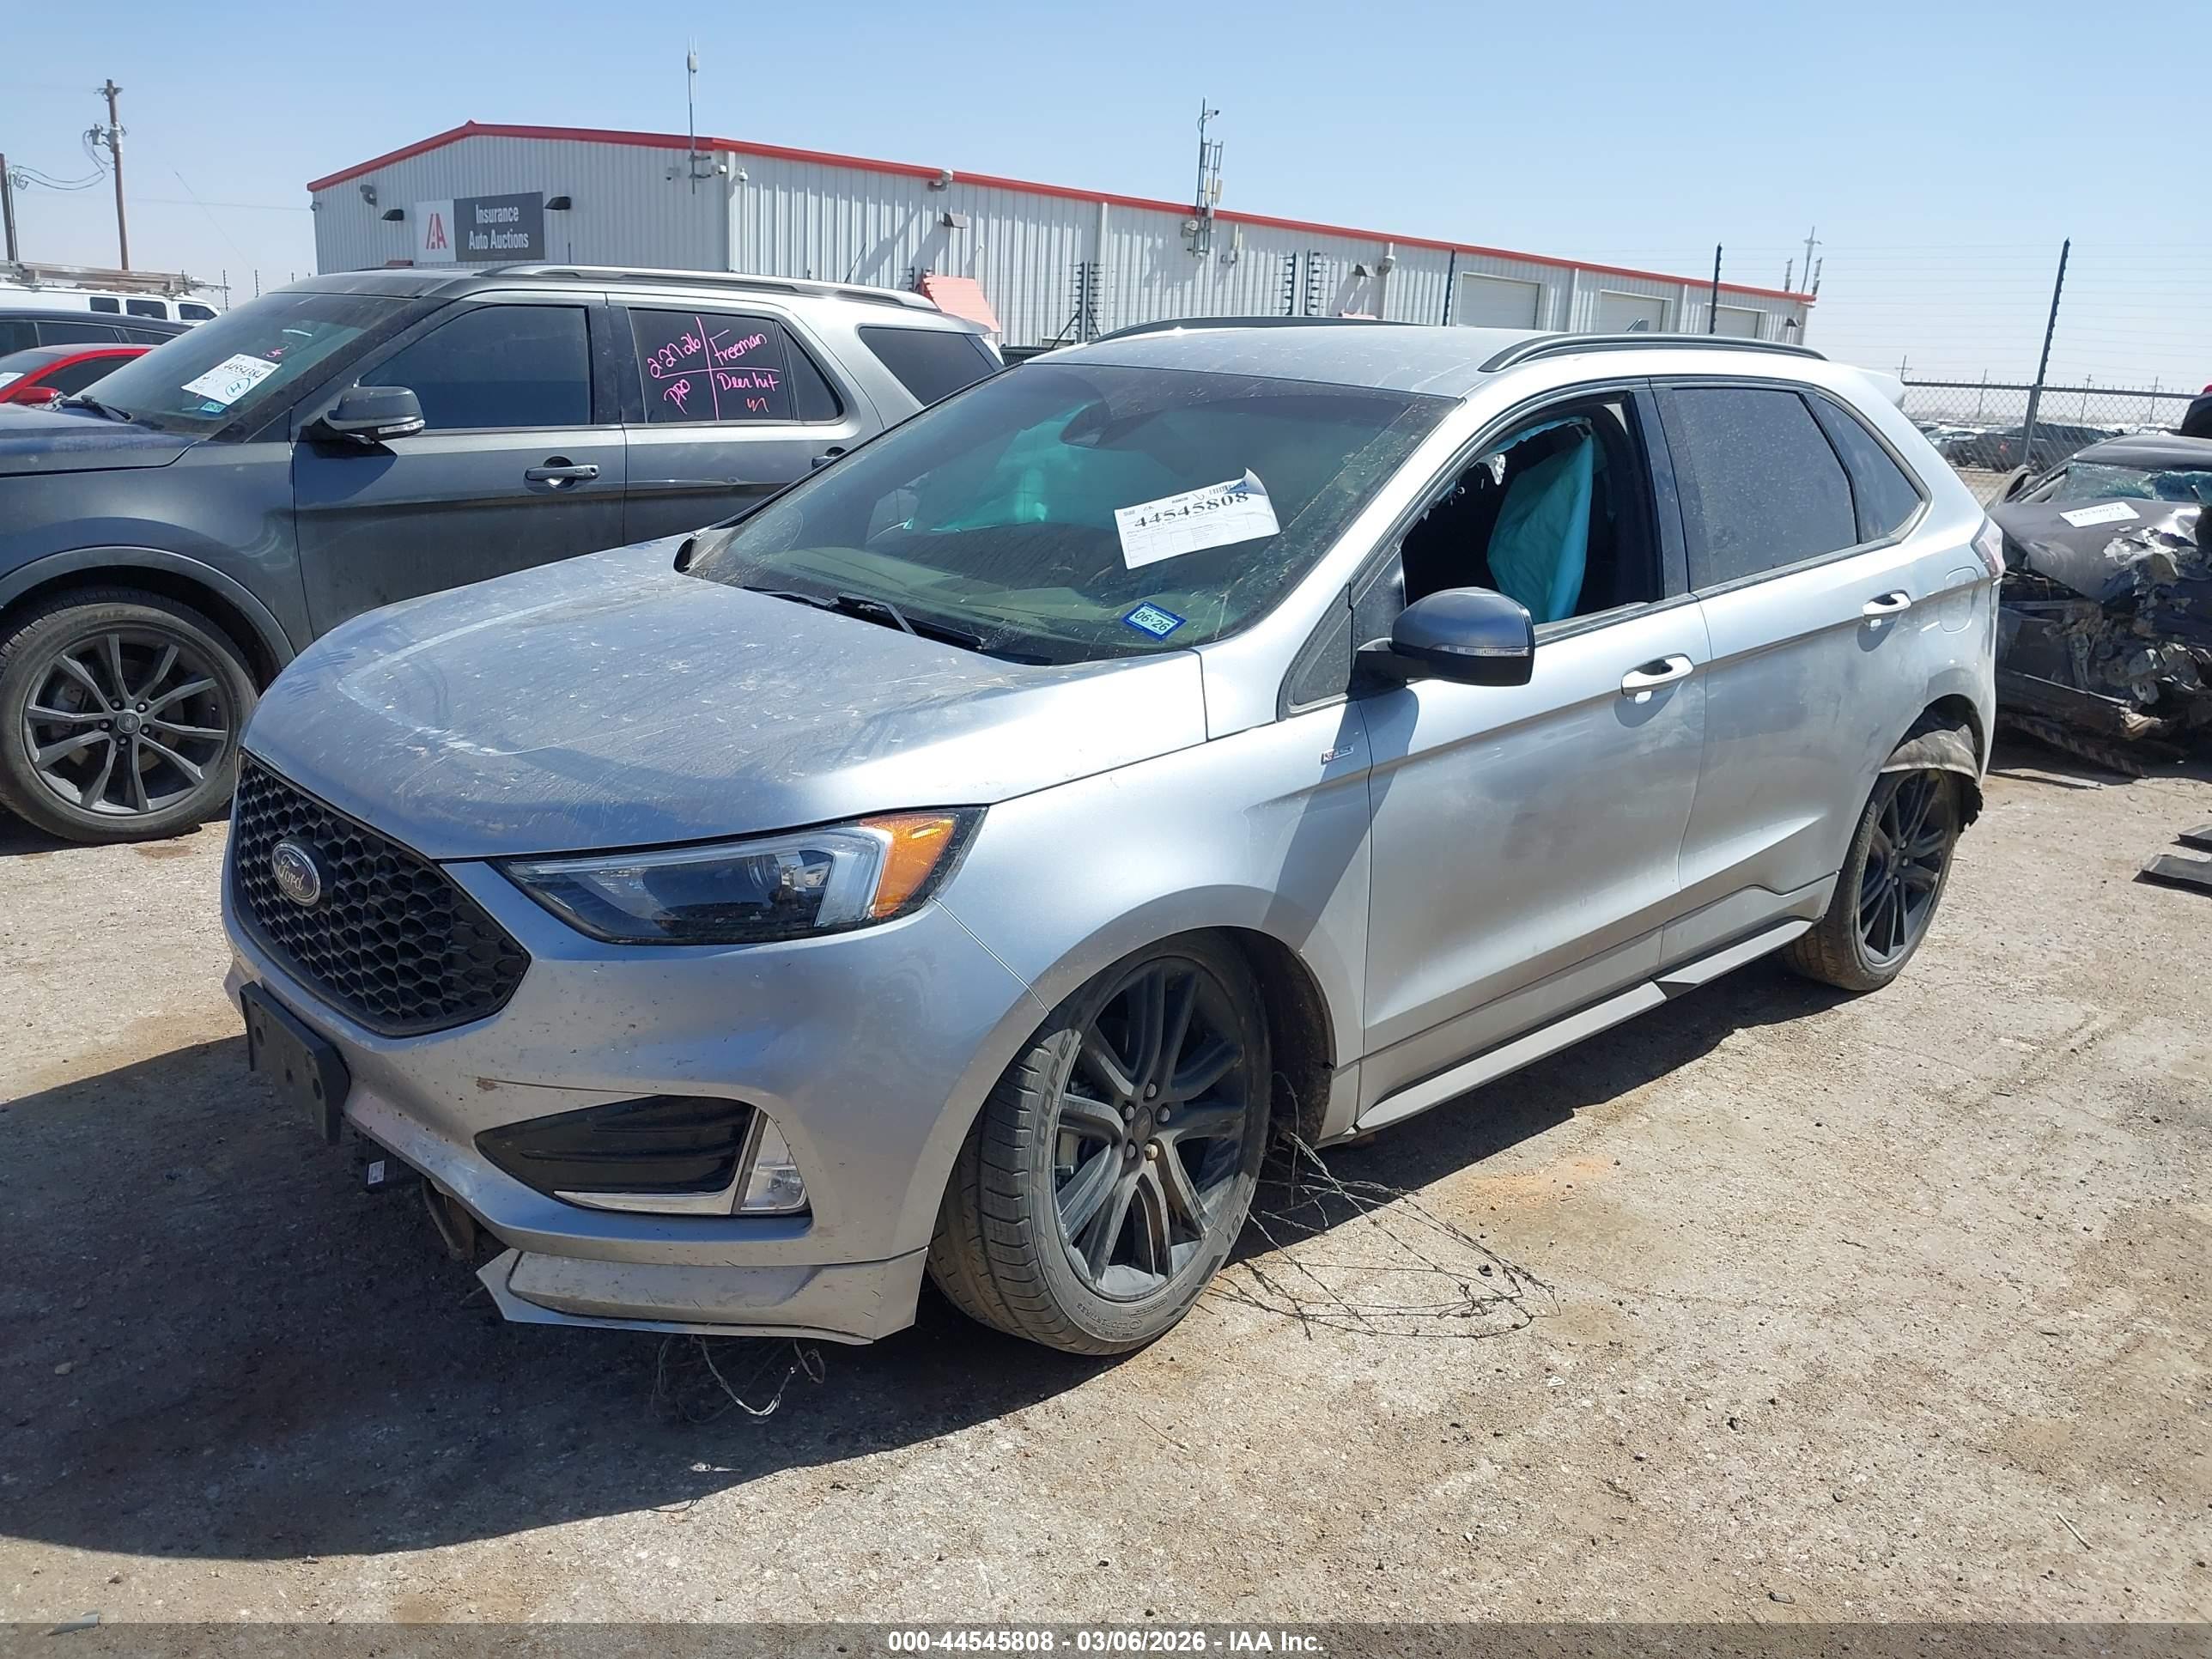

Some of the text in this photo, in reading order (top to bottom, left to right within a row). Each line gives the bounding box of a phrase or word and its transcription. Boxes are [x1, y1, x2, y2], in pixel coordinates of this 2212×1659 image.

[475, 204, 520, 224] Insurance
[468, 228, 529, 250] Auto Auctions
[709, 329, 767, 366] Freeman
[1134, 491, 1249, 527] 44545808
[277, 854, 306, 891] Ford
[1036, 1032, 1072, 1174] COOPE
